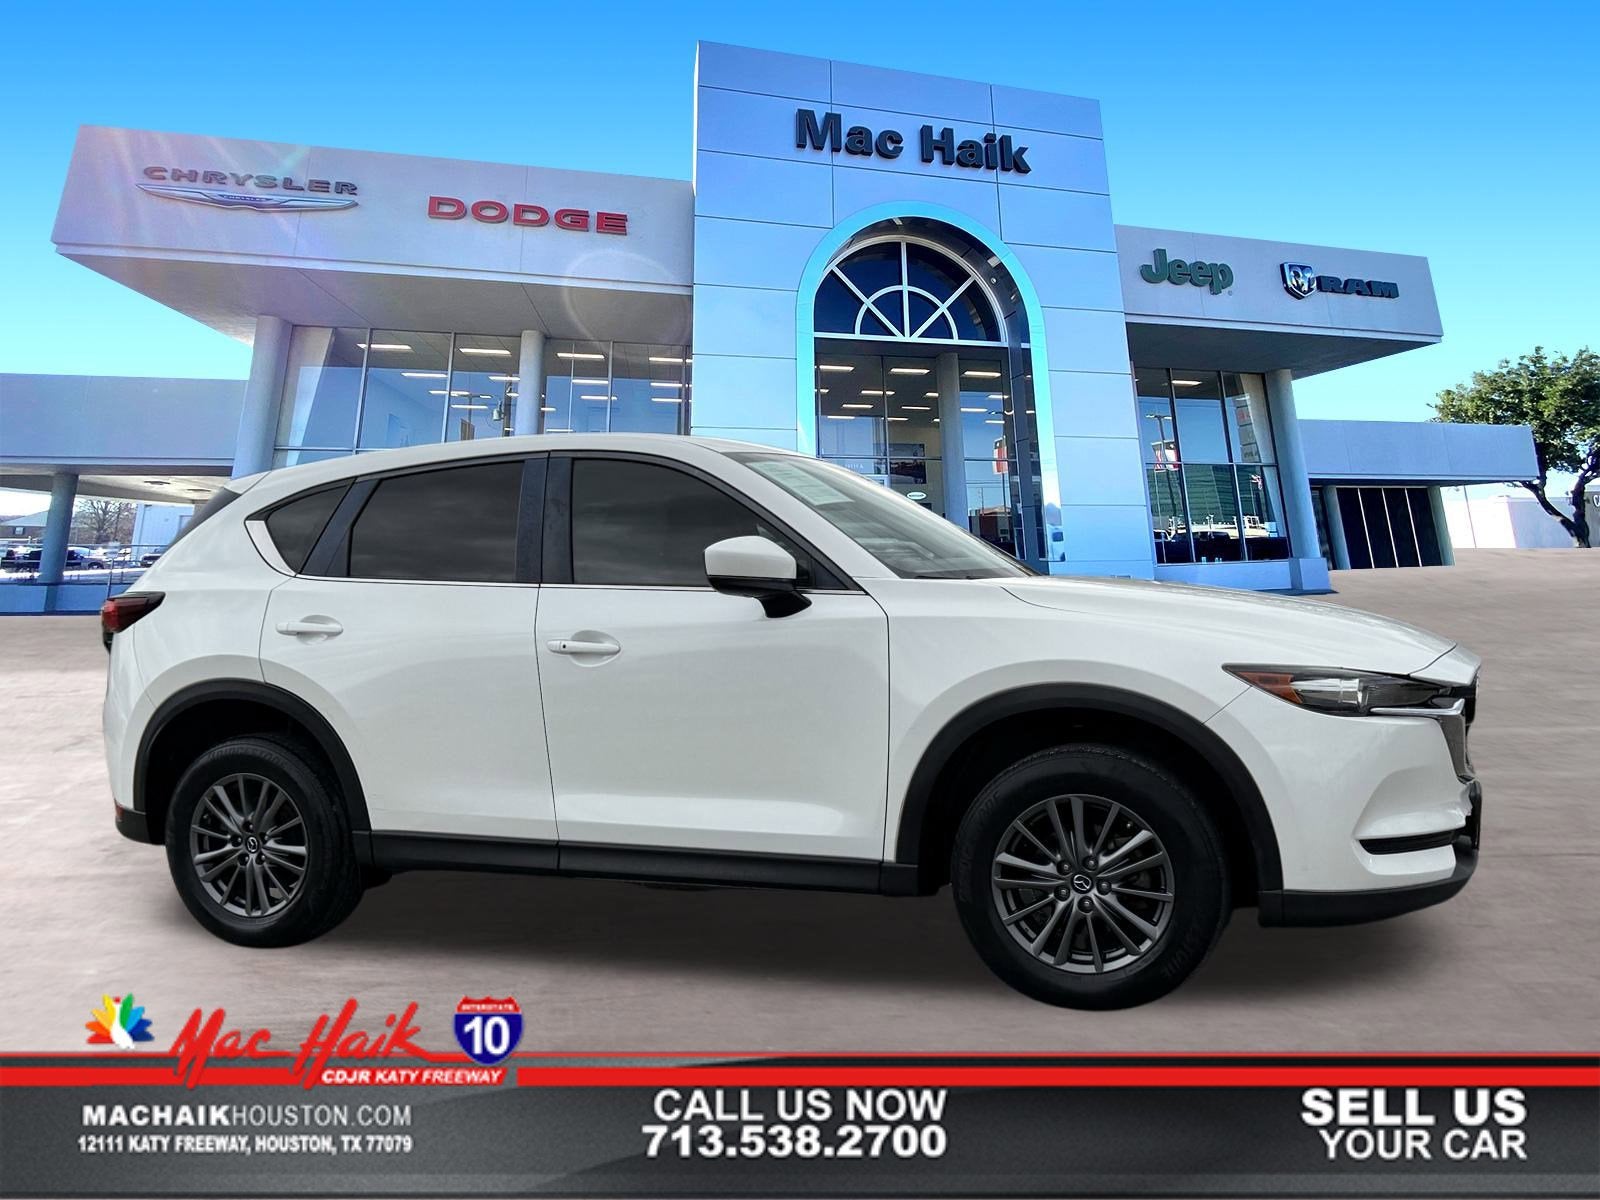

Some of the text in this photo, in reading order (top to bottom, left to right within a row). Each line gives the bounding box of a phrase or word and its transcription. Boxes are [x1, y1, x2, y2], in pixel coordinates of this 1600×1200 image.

[796, 108, 1031, 174] Mac Haik
[143, 166, 359, 196] CHRYSLER
[428, 196, 628, 236] DODGE
[1140, 248, 1234, 295] Jeep
[1315, 275, 1399, 299] RAM
